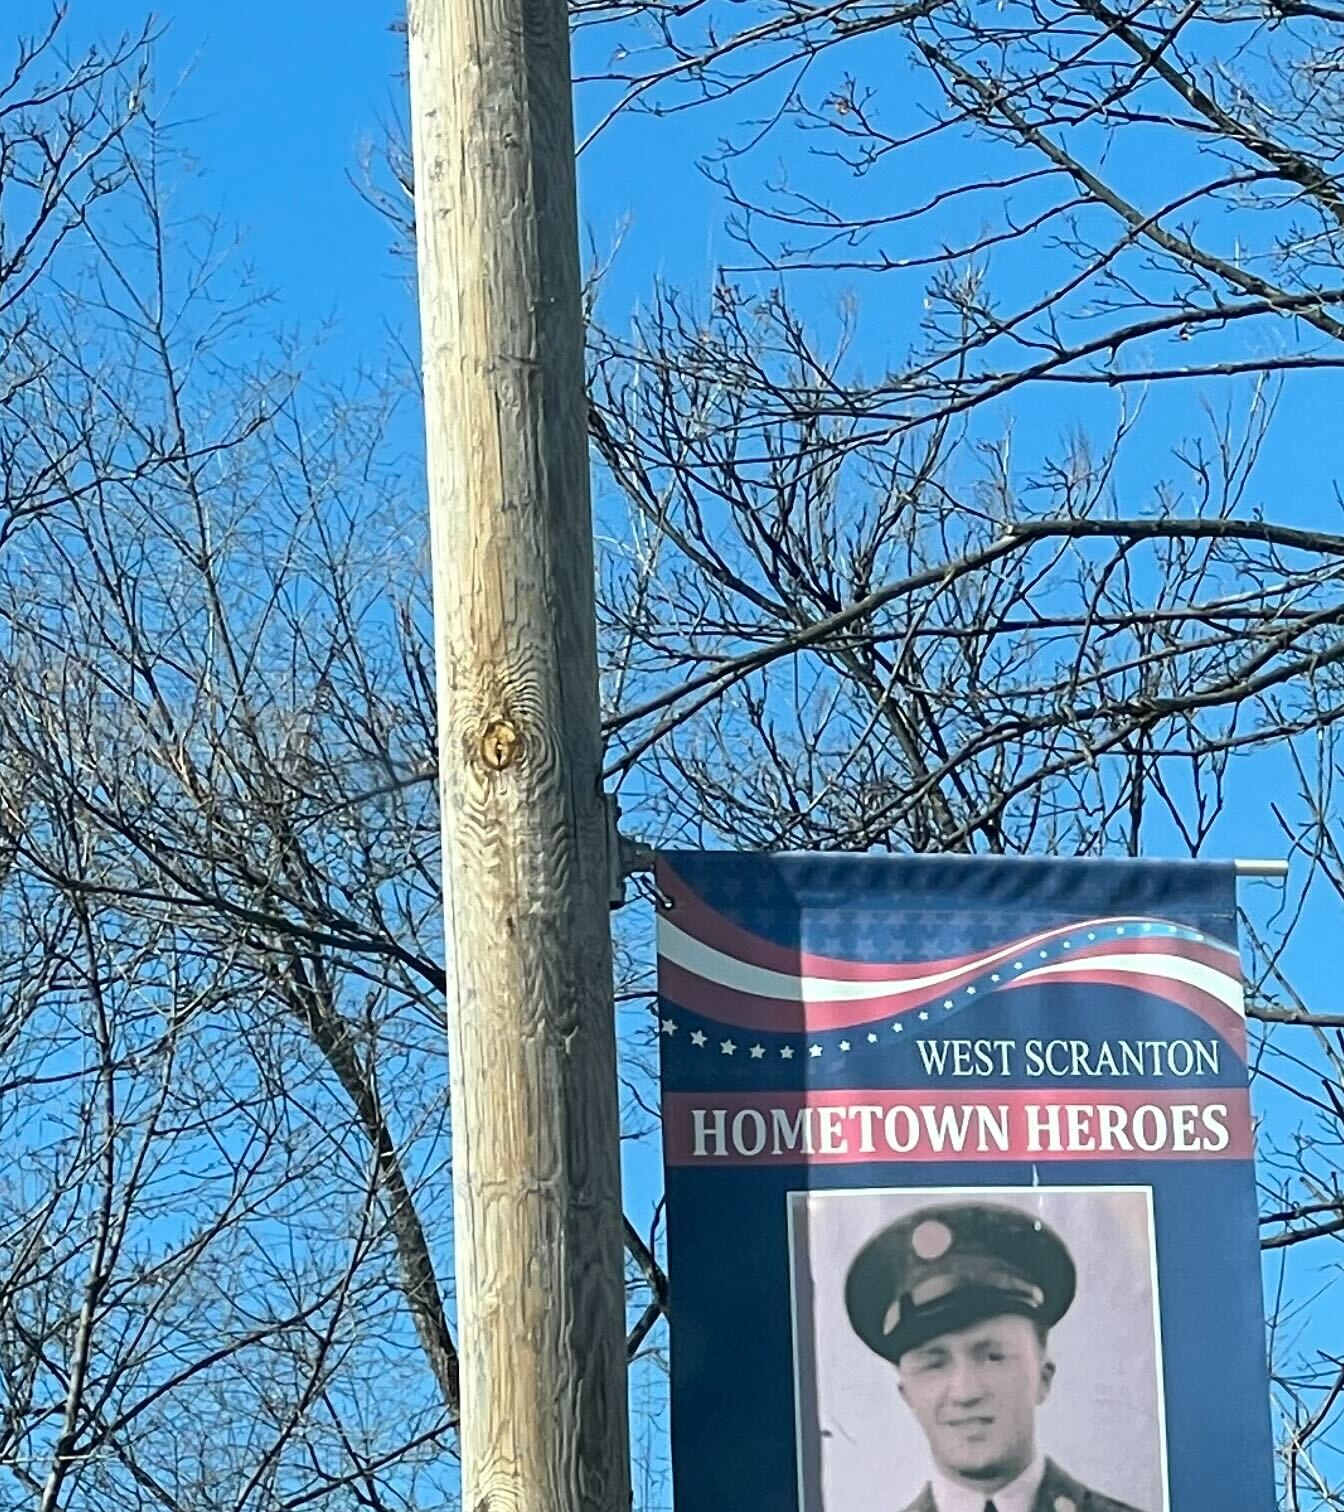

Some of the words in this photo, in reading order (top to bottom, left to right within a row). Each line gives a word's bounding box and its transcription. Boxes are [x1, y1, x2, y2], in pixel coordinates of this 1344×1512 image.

[916, 1038, 1016, 1077] WEST
[1024, 1038, 1221, 1078] SCRANTON
[691, 1104, 1010, 1157] HOMETOWN
[1025, 1103, 1230, 1154] HEROES
